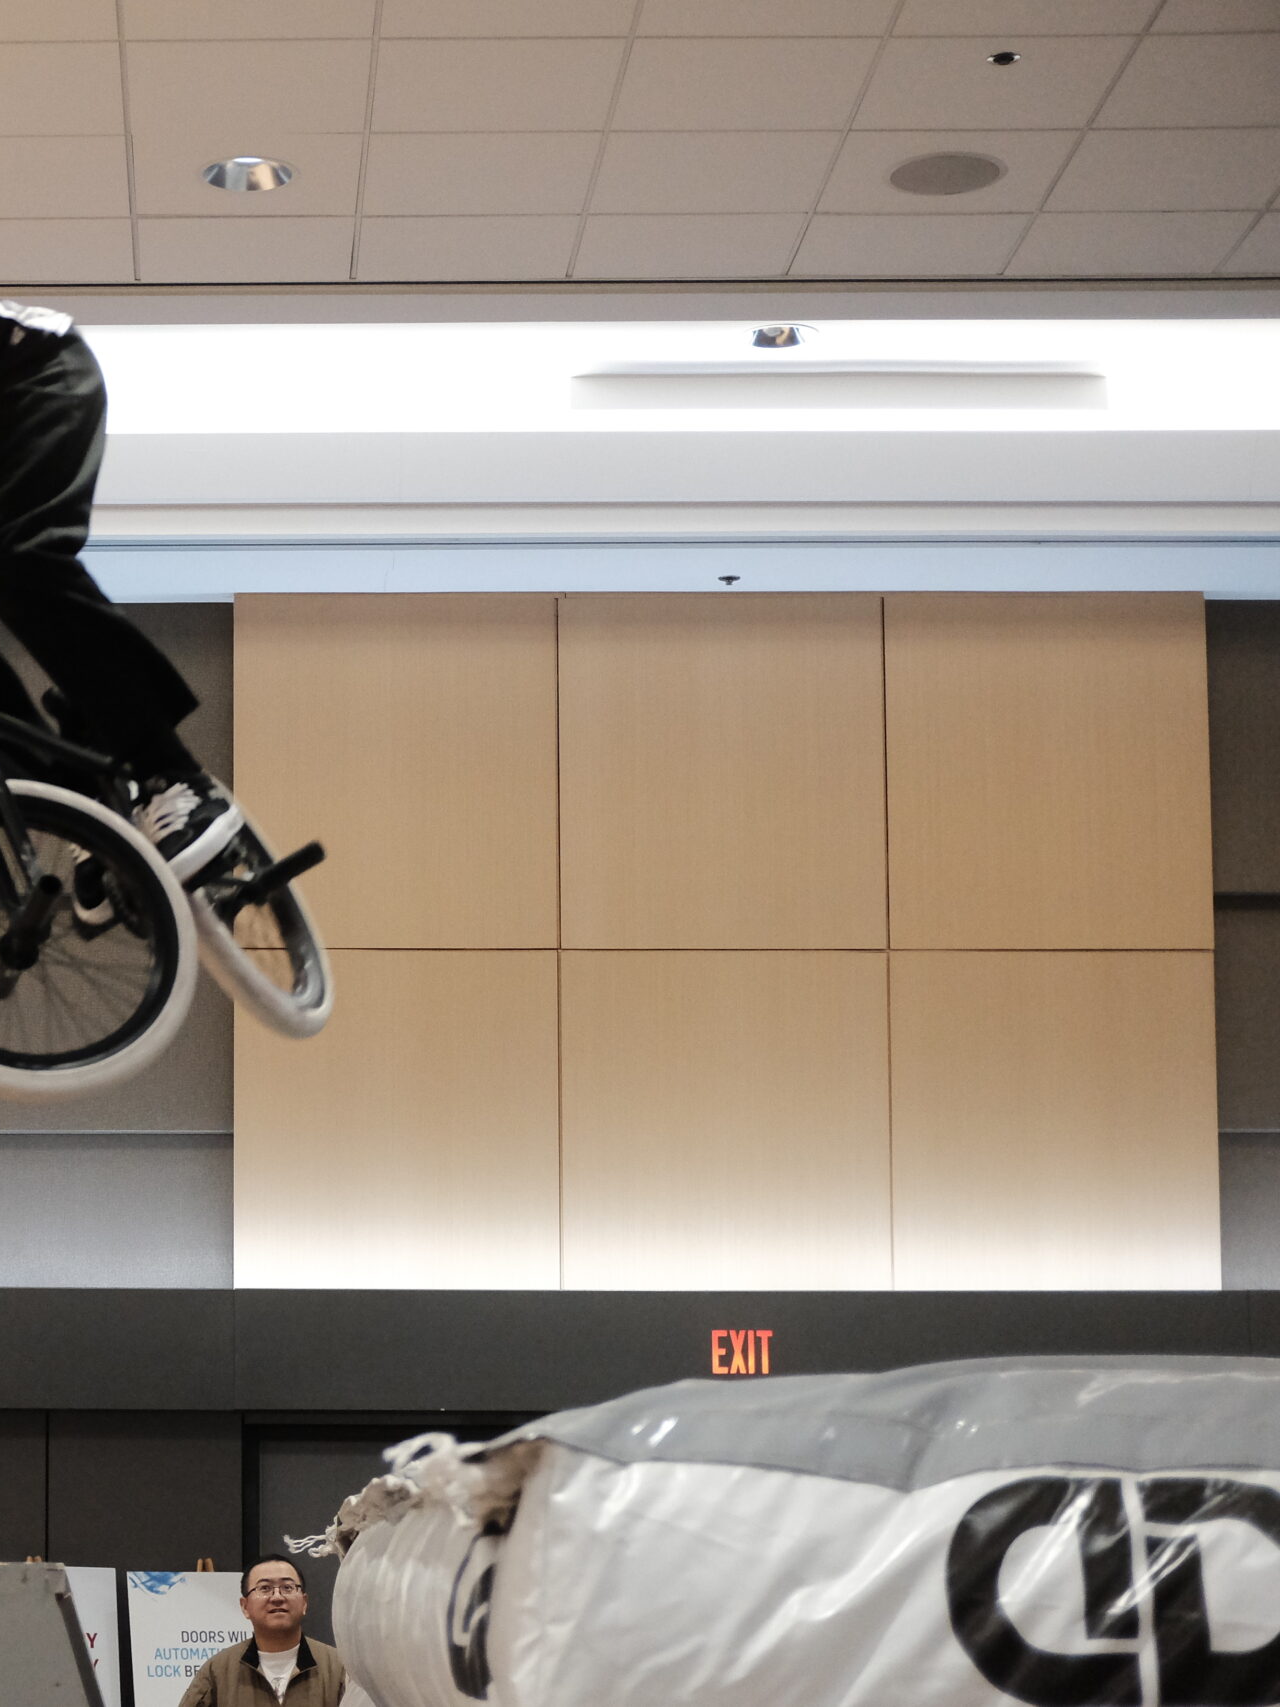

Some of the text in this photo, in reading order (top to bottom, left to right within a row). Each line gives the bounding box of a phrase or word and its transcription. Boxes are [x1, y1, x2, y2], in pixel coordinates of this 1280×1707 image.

[711, 1329, 773, 1375] EXIT
[181, 1630, 225, 1644] DOORS
[147, 1664, 181, 1678] LOCK
